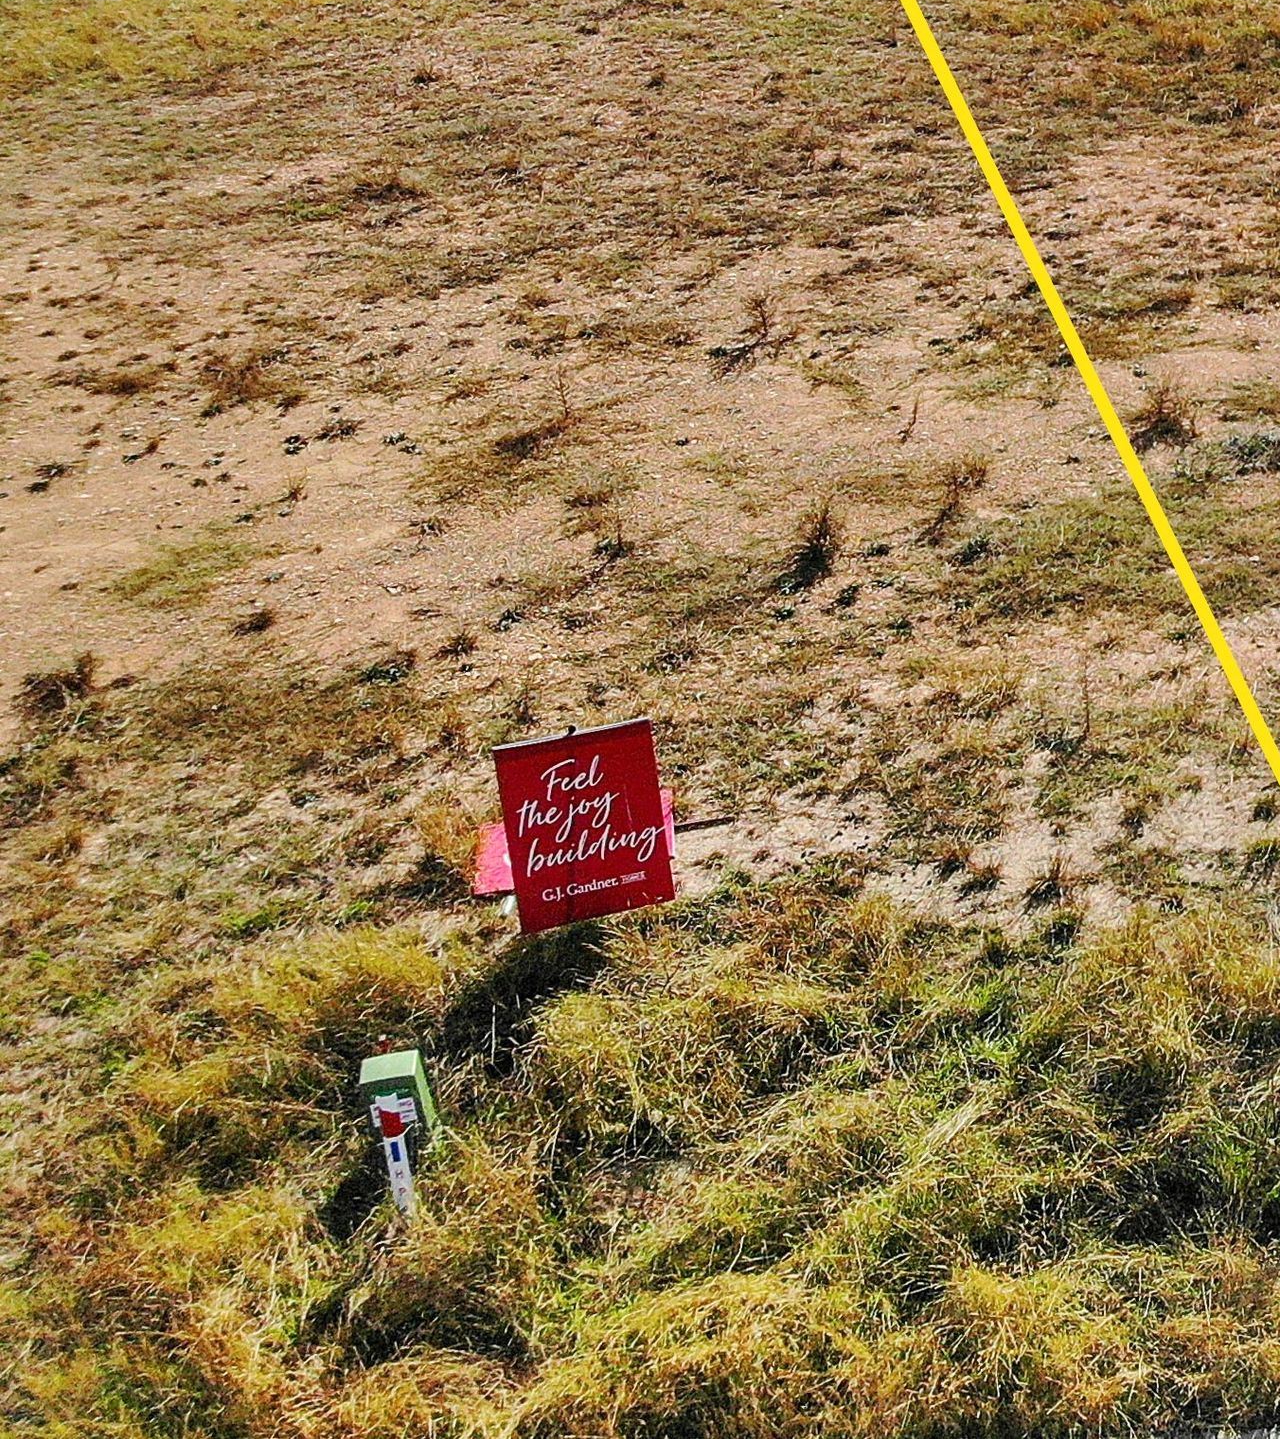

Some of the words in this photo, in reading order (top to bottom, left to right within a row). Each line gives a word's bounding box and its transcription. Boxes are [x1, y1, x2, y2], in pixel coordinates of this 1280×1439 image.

[540, 755, 604, 801] Feel
[516, 799, 563, 838] the
[555, 791, 620, 843] joy
[526, 824, 666, 878] building
